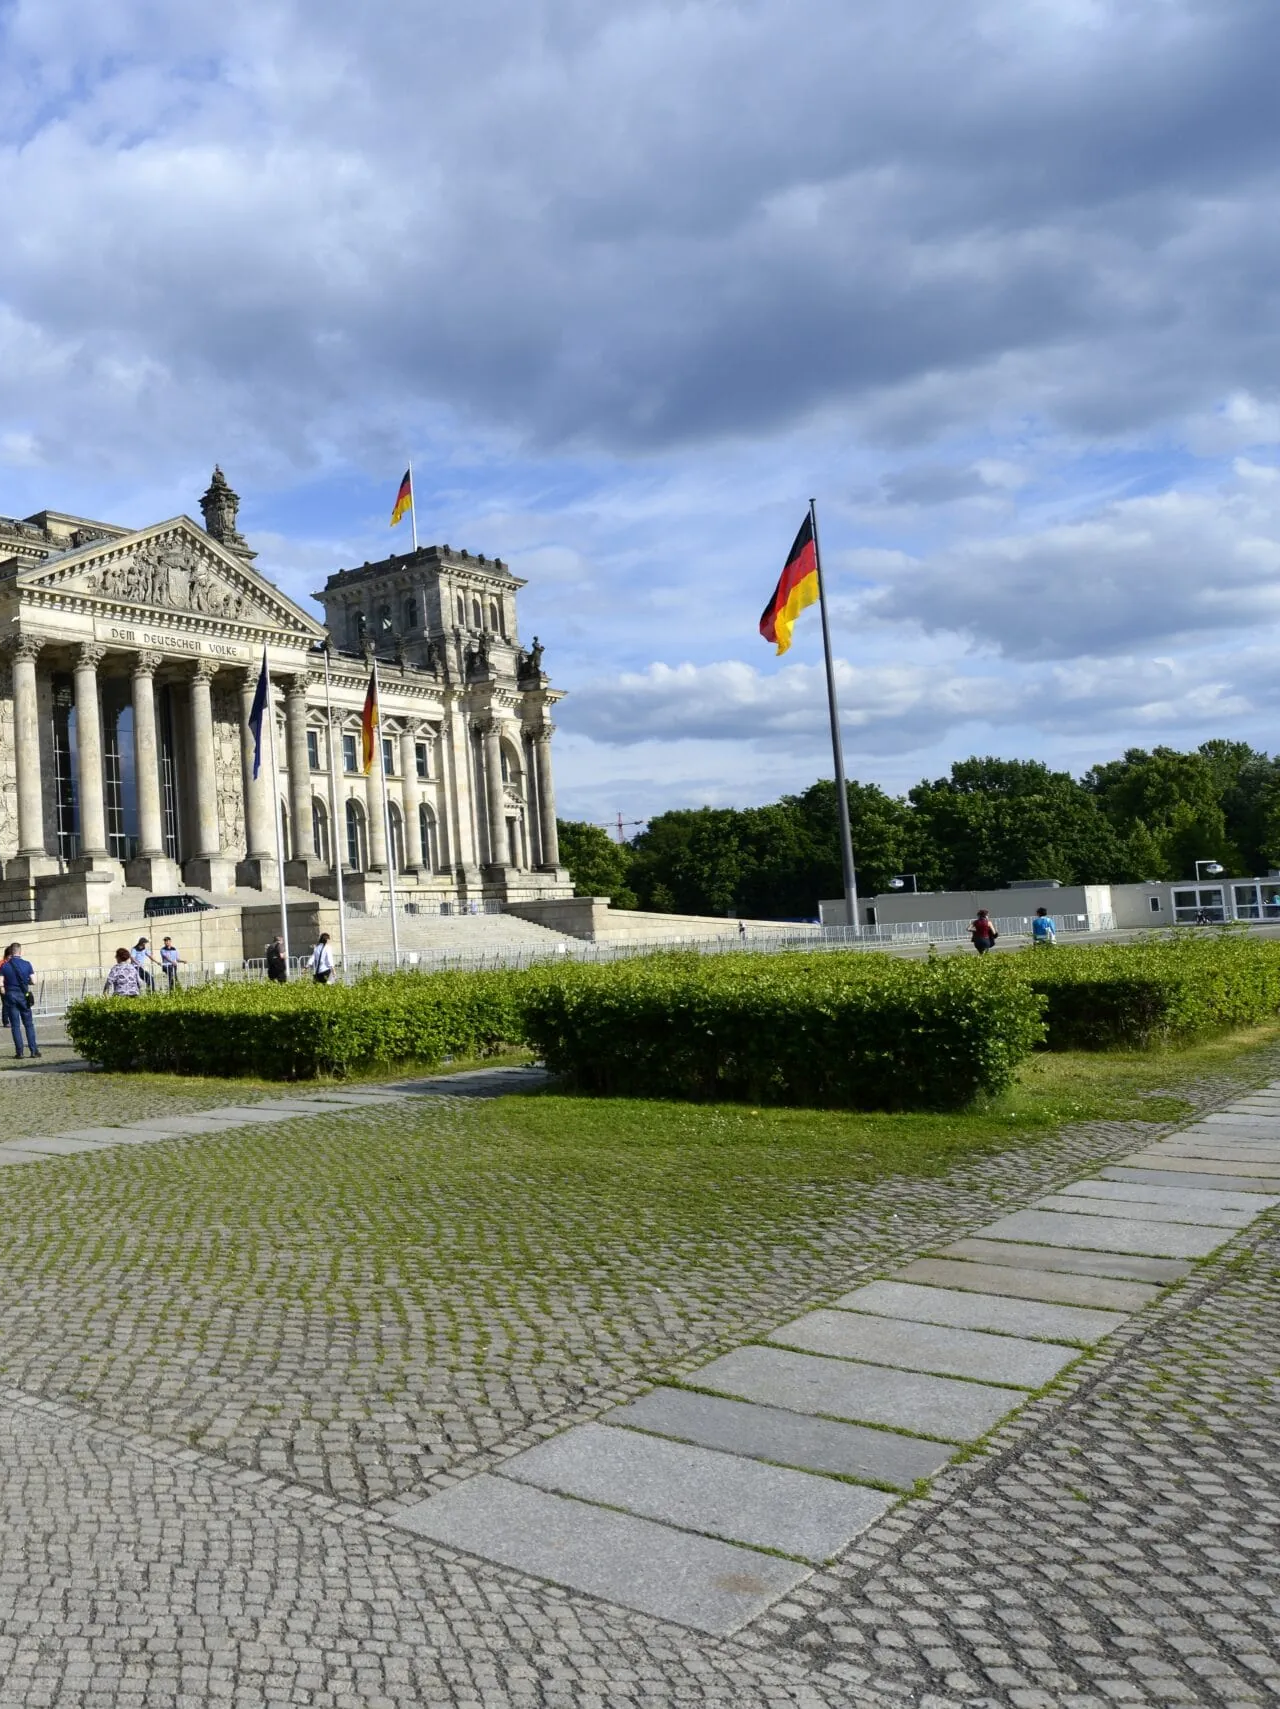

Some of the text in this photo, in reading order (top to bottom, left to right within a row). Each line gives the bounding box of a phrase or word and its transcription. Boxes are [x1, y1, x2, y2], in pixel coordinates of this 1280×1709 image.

[111, 628, 237, 657] DEM DEUTSCHEN VOLKE
